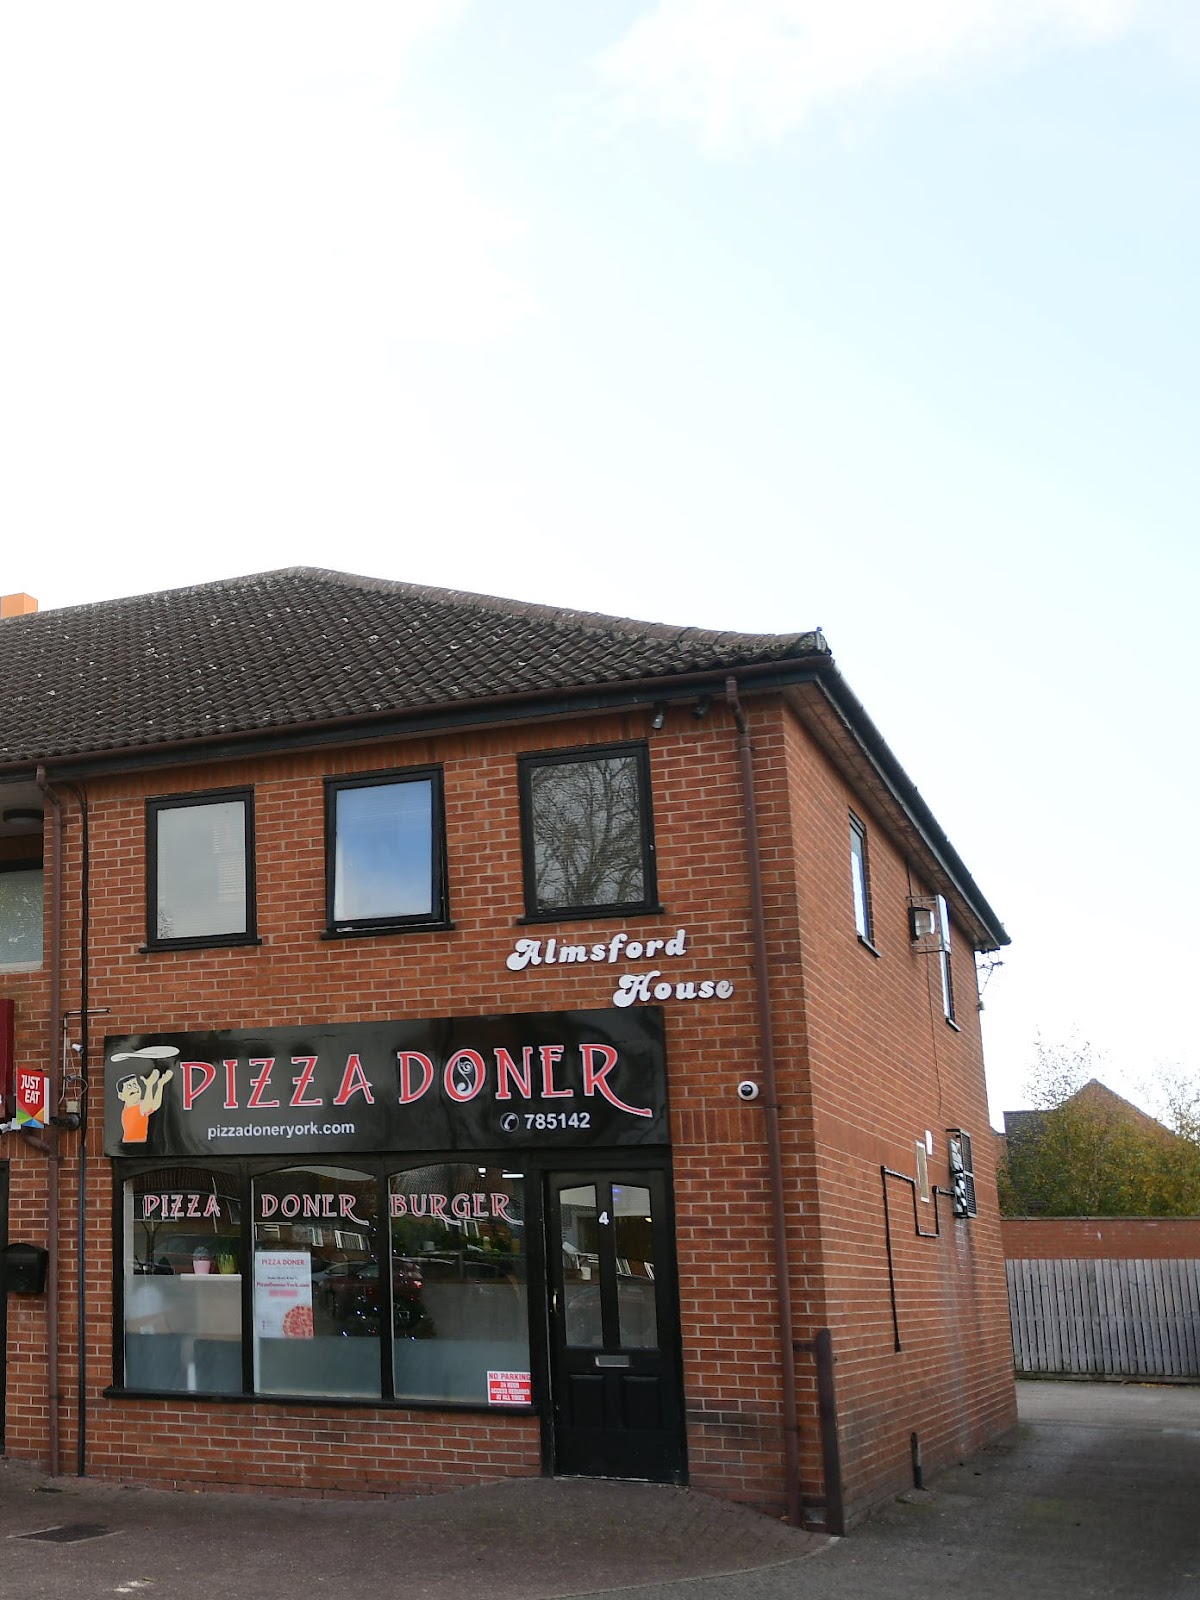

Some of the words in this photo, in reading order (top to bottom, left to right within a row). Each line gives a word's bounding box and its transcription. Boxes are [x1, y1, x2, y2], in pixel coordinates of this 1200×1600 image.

[505, 929, 687, 971] Almsford
[612, 970, 734, 1008] House
[20, 1074, 40, 1090] JUST
[179, 1053, 375, 1111] PIZZA
[396, 1043, 653, 1119] DONER
[24, 1089, 40, 1104] EAT
[207, 1120, 356, 1140] pizzadoneryork.com
[523, 1111, 591, 1131] 785142
[143, 1193, 221, 1218] PIZZA
[261, 1193, 370, 1226] DONER
[390, 1192, 524, 1226] BURGER
[599, 1211, 609, 1225] 4
[489, 1372, 498, 1380] NO
[500, 1373, 531, 1381] PARKING
